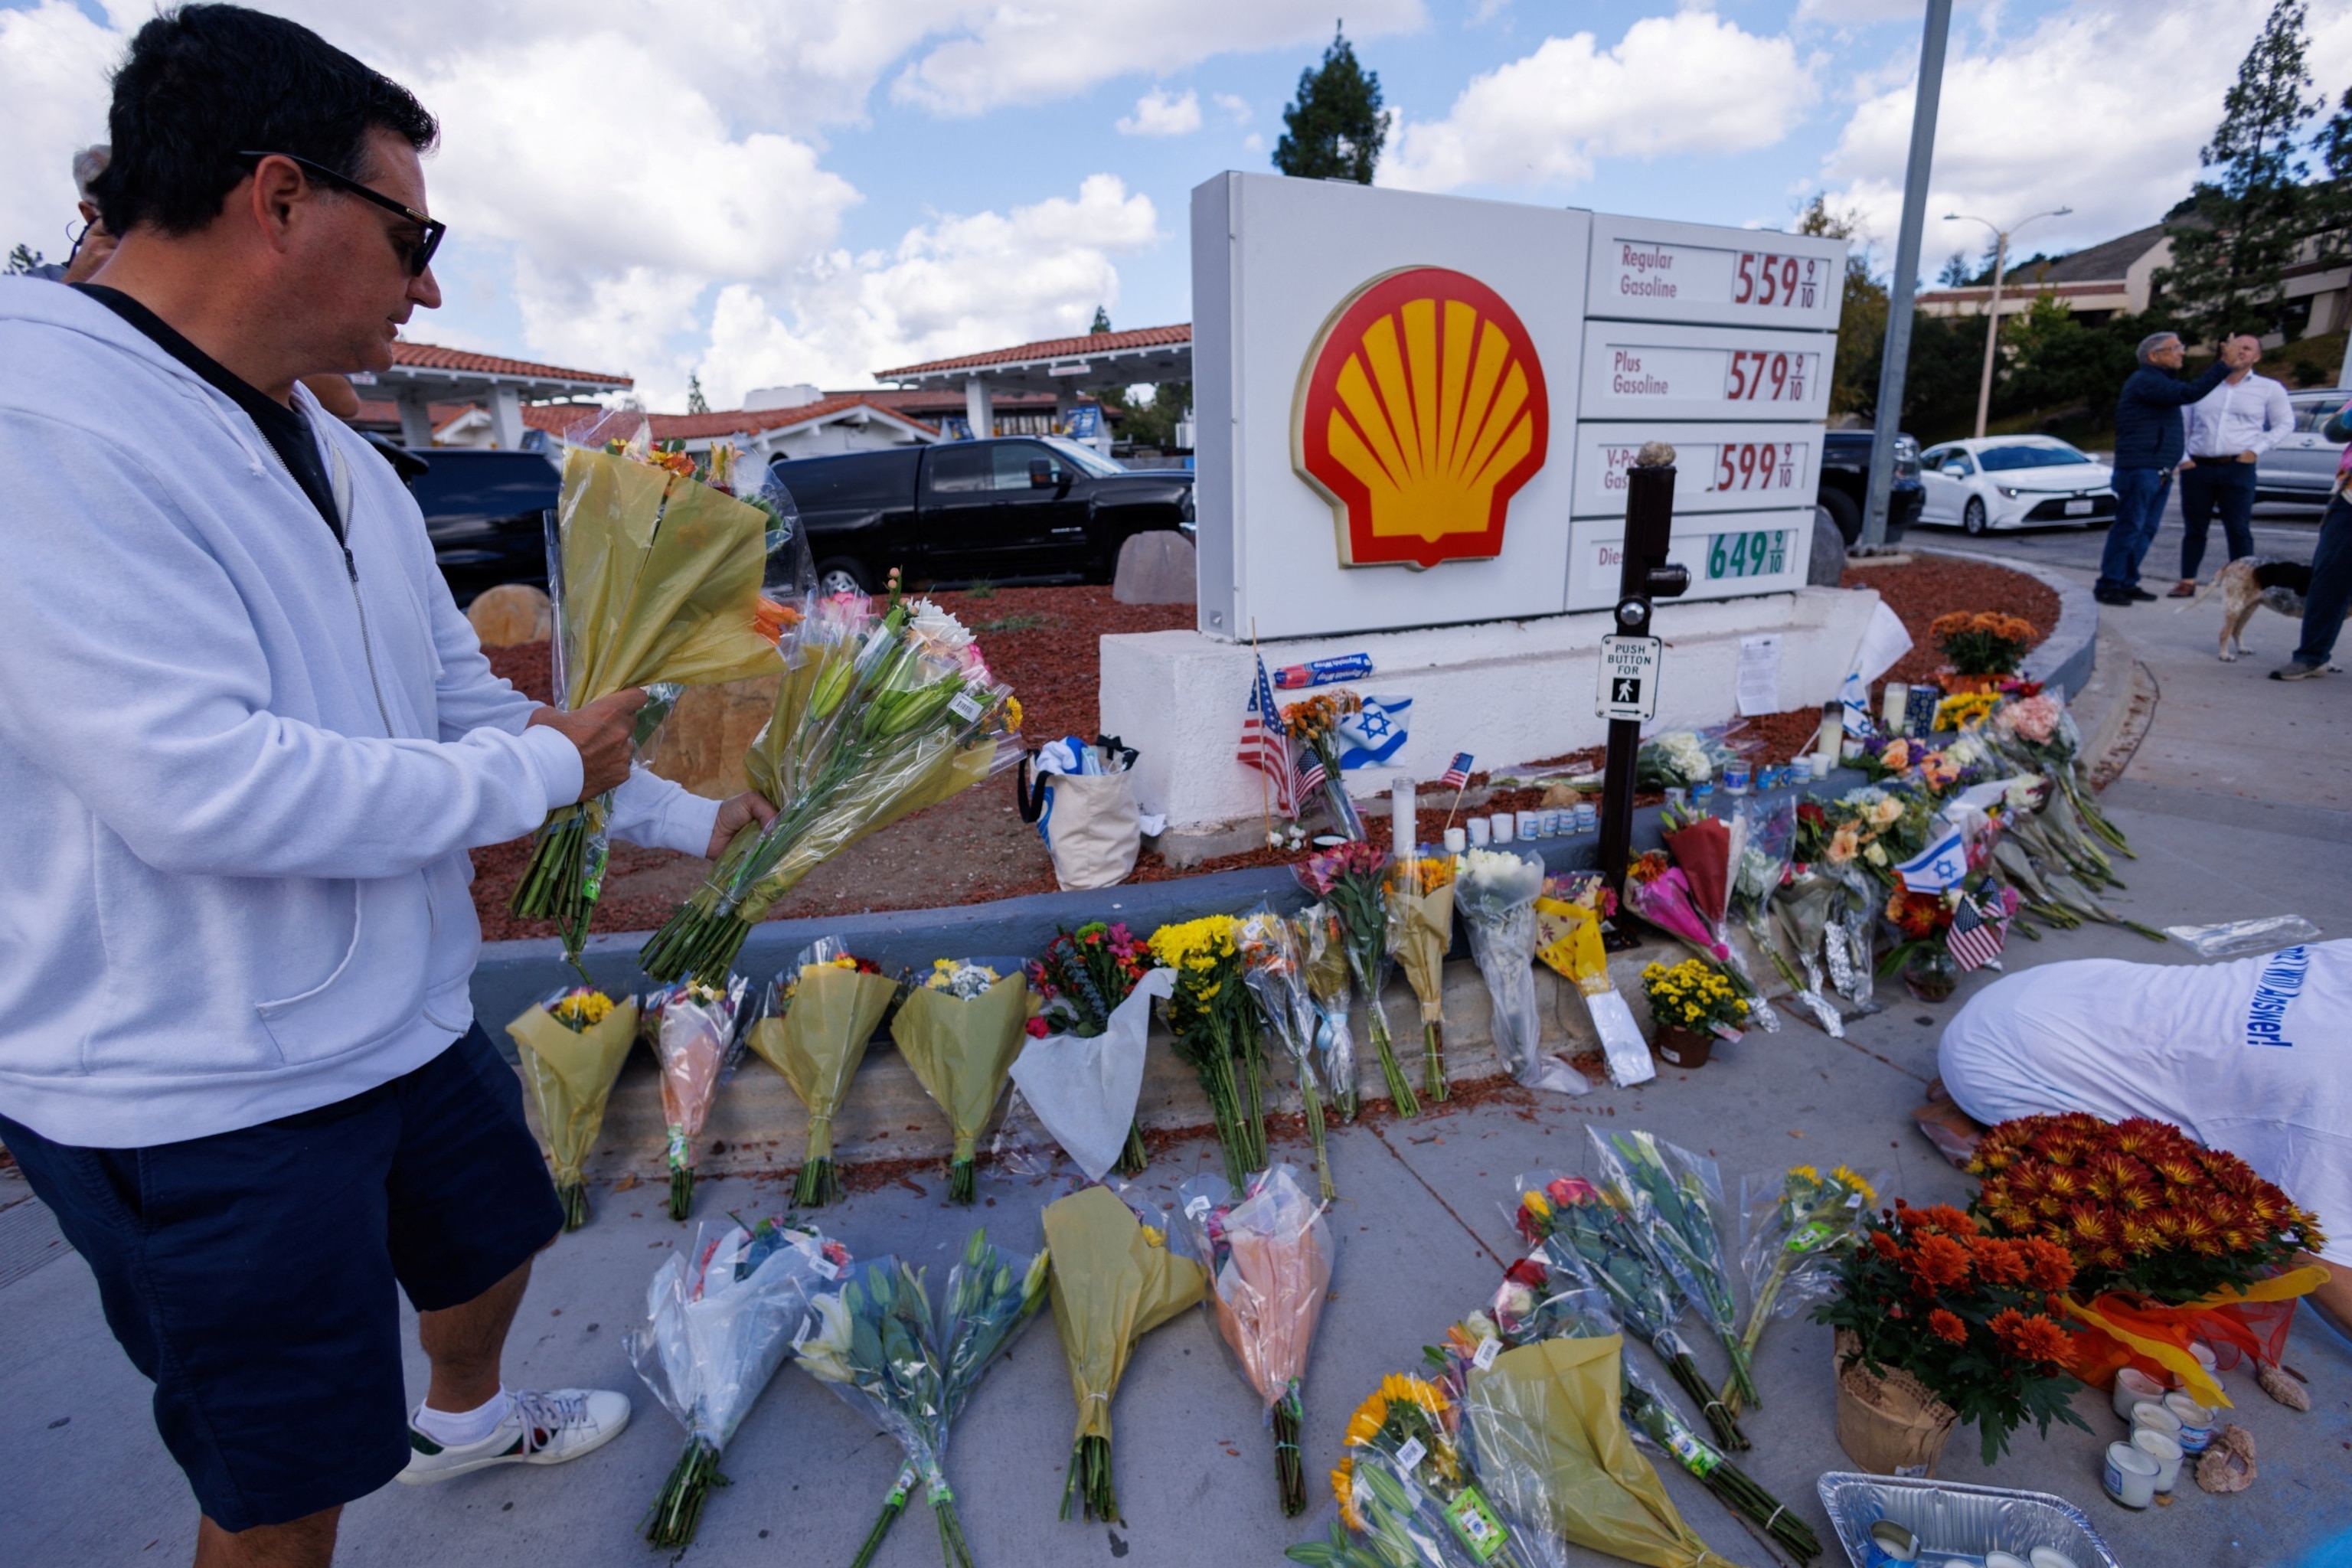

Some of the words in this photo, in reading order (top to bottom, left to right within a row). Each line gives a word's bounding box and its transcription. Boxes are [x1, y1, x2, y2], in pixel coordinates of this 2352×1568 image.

[1622, 245, 1673, 272] Regular
[1620, 275, 1677, 299] Gasoline
[1735, 254, 1799, 306] 559
[1614, 351, 1642, 373] Plus
[1613, 374, 1669, 395] Gasoline
[1727, 351, 1789, 400] 579
[1717, 443, 1776, 492] 599
[1709, 531, 1768, 579] 649
[1607, 655, 1651, 665] BUTTON
[1615, 644, 1646, 654] PUSH
[1617, 665, 1639, 675] FOR
[2260, 966, 2308, 988] Will
[2246, 985, 2301, 1047] Answer!
